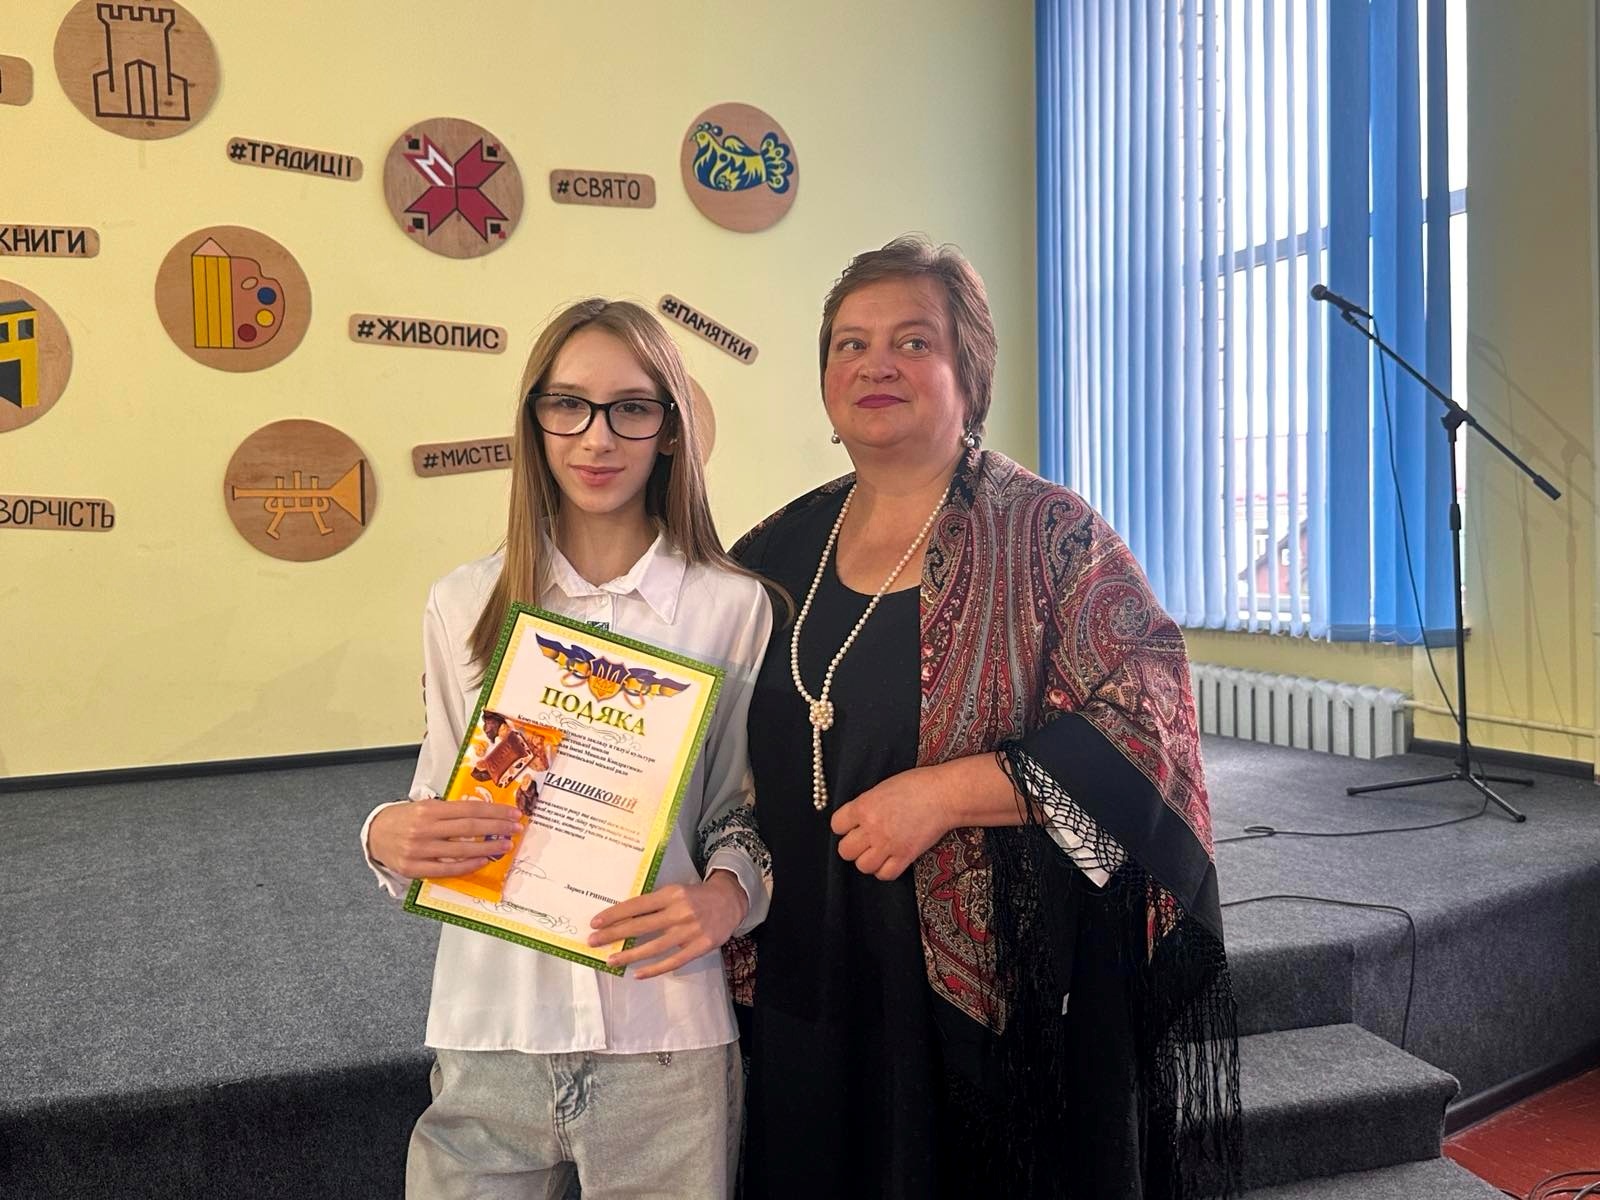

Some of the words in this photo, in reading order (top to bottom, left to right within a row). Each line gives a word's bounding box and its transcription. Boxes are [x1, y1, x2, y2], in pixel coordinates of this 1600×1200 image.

[230, 142, 354, 177] #ТРАДИЦІЇ
[357, 318, 499, 349] #ЖИВОПИС
[662, 298, 753, 360] #ПАМЯТКИ
[540, 686, 646, 736] ПОДЯКА
